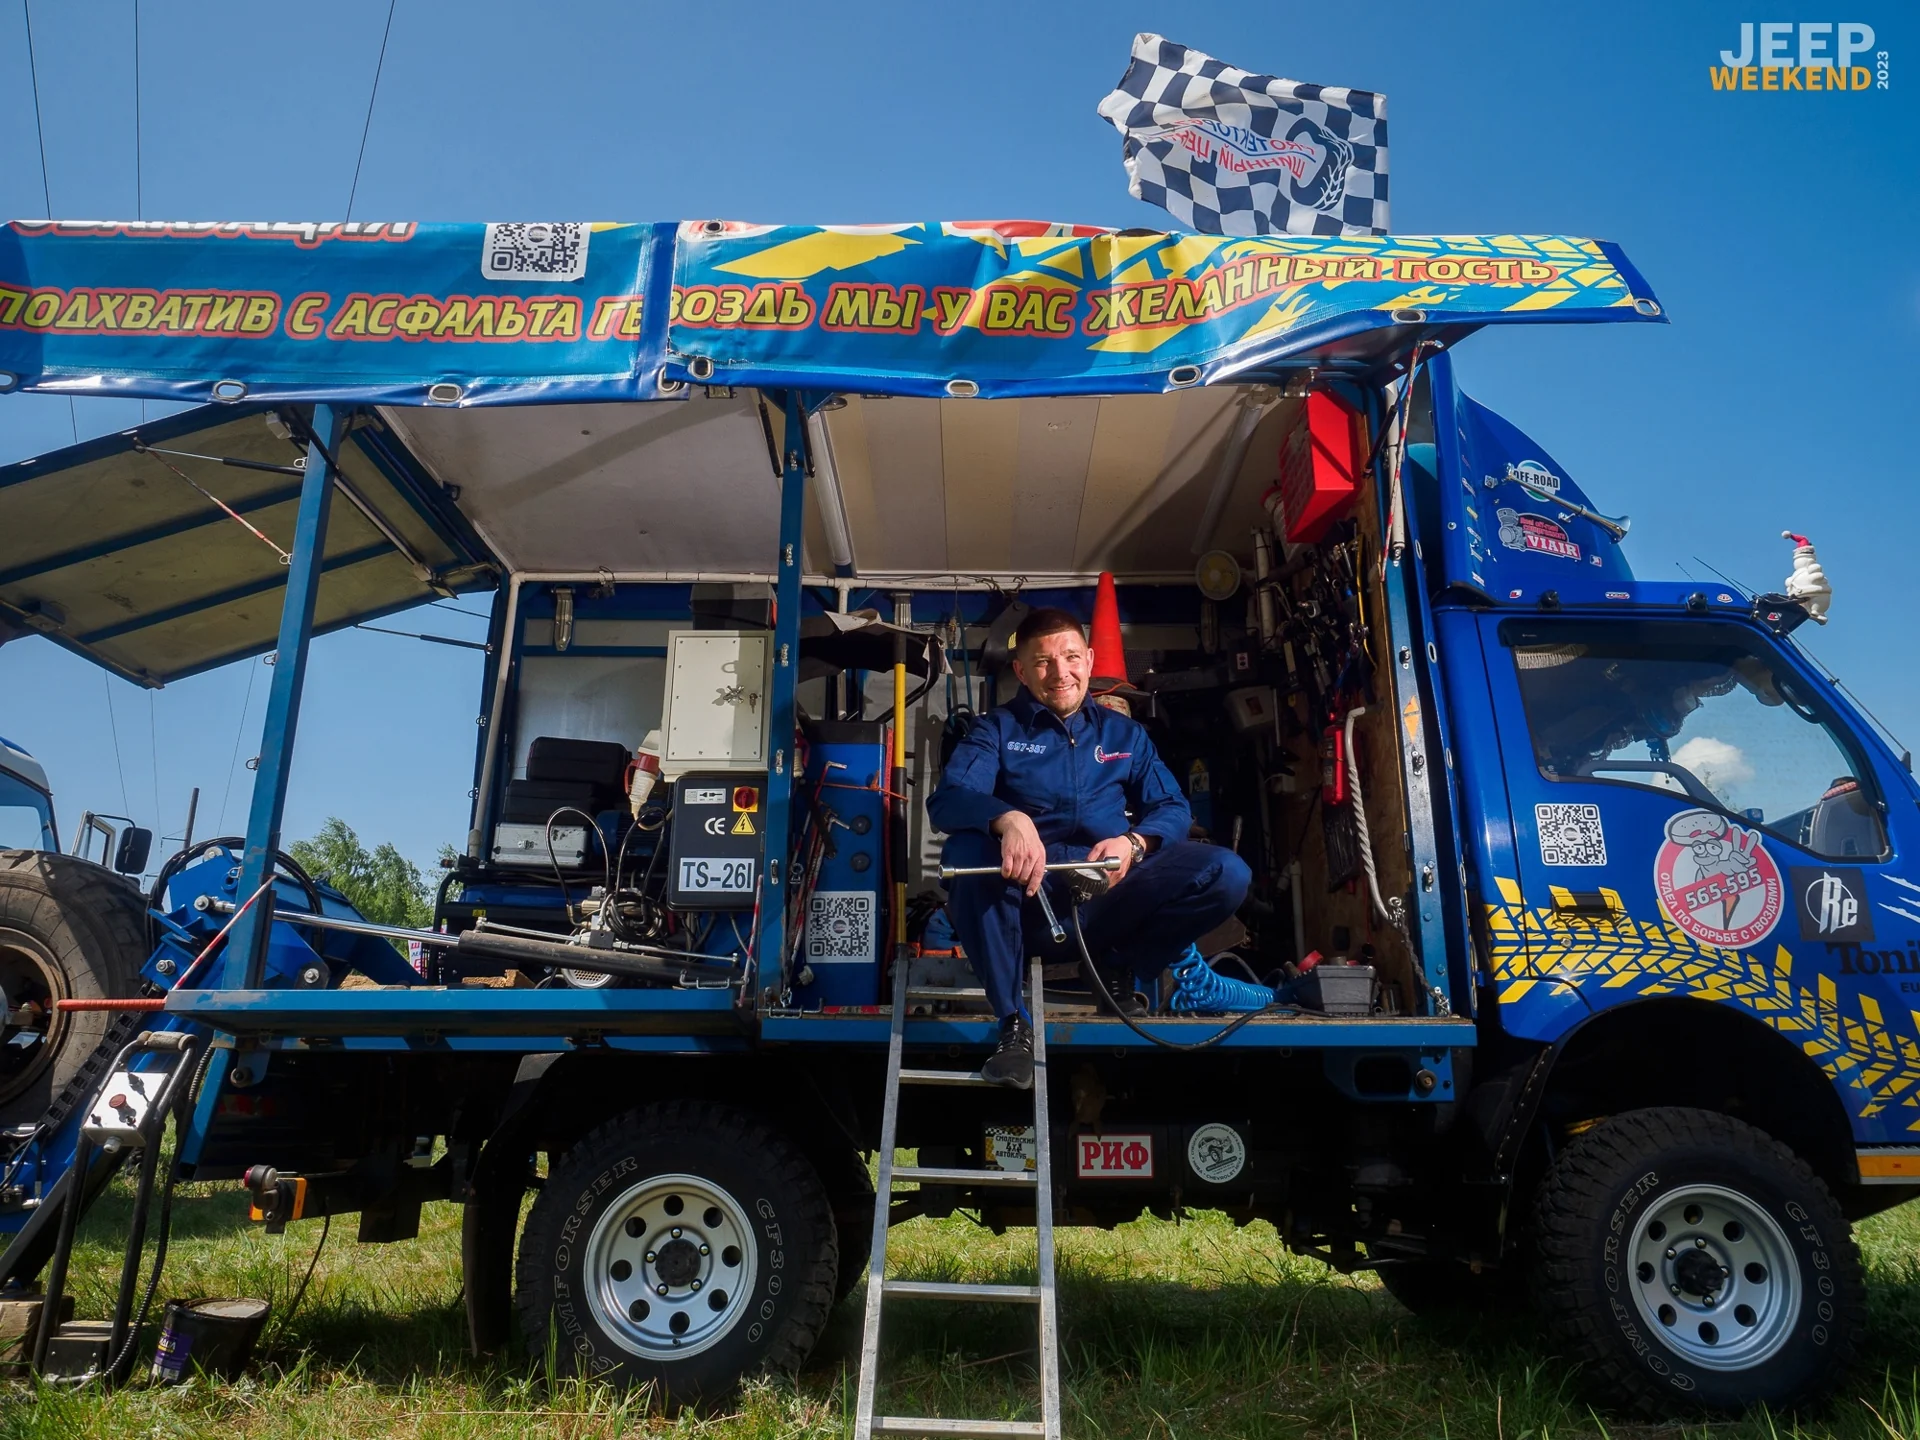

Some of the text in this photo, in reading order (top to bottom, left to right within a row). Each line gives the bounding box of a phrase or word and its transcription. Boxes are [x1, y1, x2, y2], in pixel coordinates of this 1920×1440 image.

[0, 286, 277, 336] ПОДХВАТИВ
[290, 297, 325, 335] С
[334, 298, 579, 338] АСФАЛЬТА
[827, 286, 918, 330] МЫ
[937, 291, 971, 330] У
[985, 291, 1073, 332] ВАС
[1087, 255, 1379, 332] ЖЕЛАННЫЙ
[1398, 258, 1554, 283] ГОСТЬ
[1513, 469, 1559, 489] OFF-ROAD
[1527, 534, 1579, 557] VIAIR
[1660, 872, 1777, 944] ОТДЕЛ ПО БОРЬБЕ С ГВОЗДЯМИ
[1684, 867, 1763, 910] 565-595
[1081, 1141, 1149, 1170] РИФ
[1206, 1168, 1236, 1181] CHEVROLET
[747, 1197, 784, 1343] CF3000
[1604, 1171, 1696, 1392] COMFORSER
[1785, 1201, 1834, 1346] CF3000
